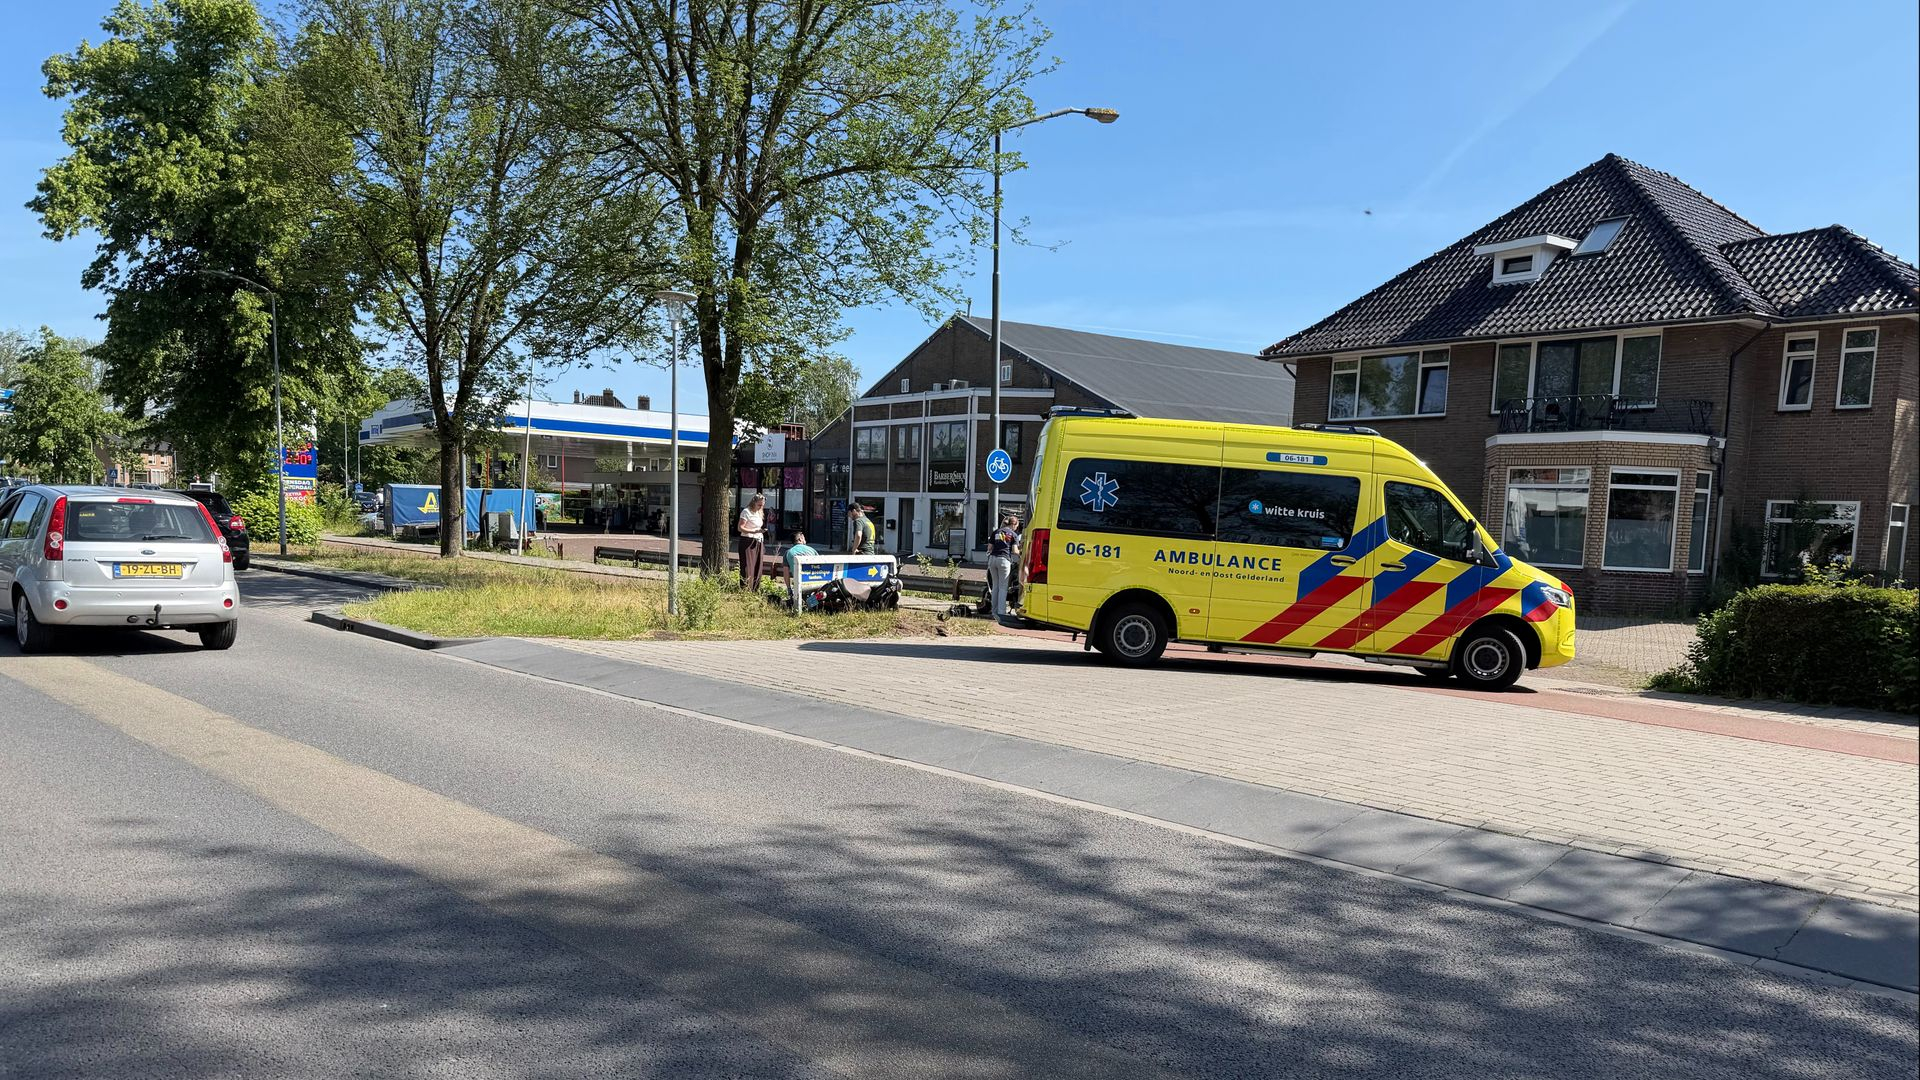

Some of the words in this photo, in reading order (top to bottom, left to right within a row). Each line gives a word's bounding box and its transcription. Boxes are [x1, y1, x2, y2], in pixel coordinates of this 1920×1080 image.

[1284, 455, 1309, 463] 06-181
[1265, 505, 1295, 517] witte
[1297, 508, 1325, 520] kruis
[1065, 542, 1121, 559] 06-181
[1153, 549, 1282, 572] AMBULANCE
[126, 563, 177, 575] 19-ZL-BH
[1168, 567, 1198, 577] Noord-
[1200, 570, 1211, 578] en
[1213, 571, 1234, 580] Oost
[1235, 573, 1285, 584] Gelderland
